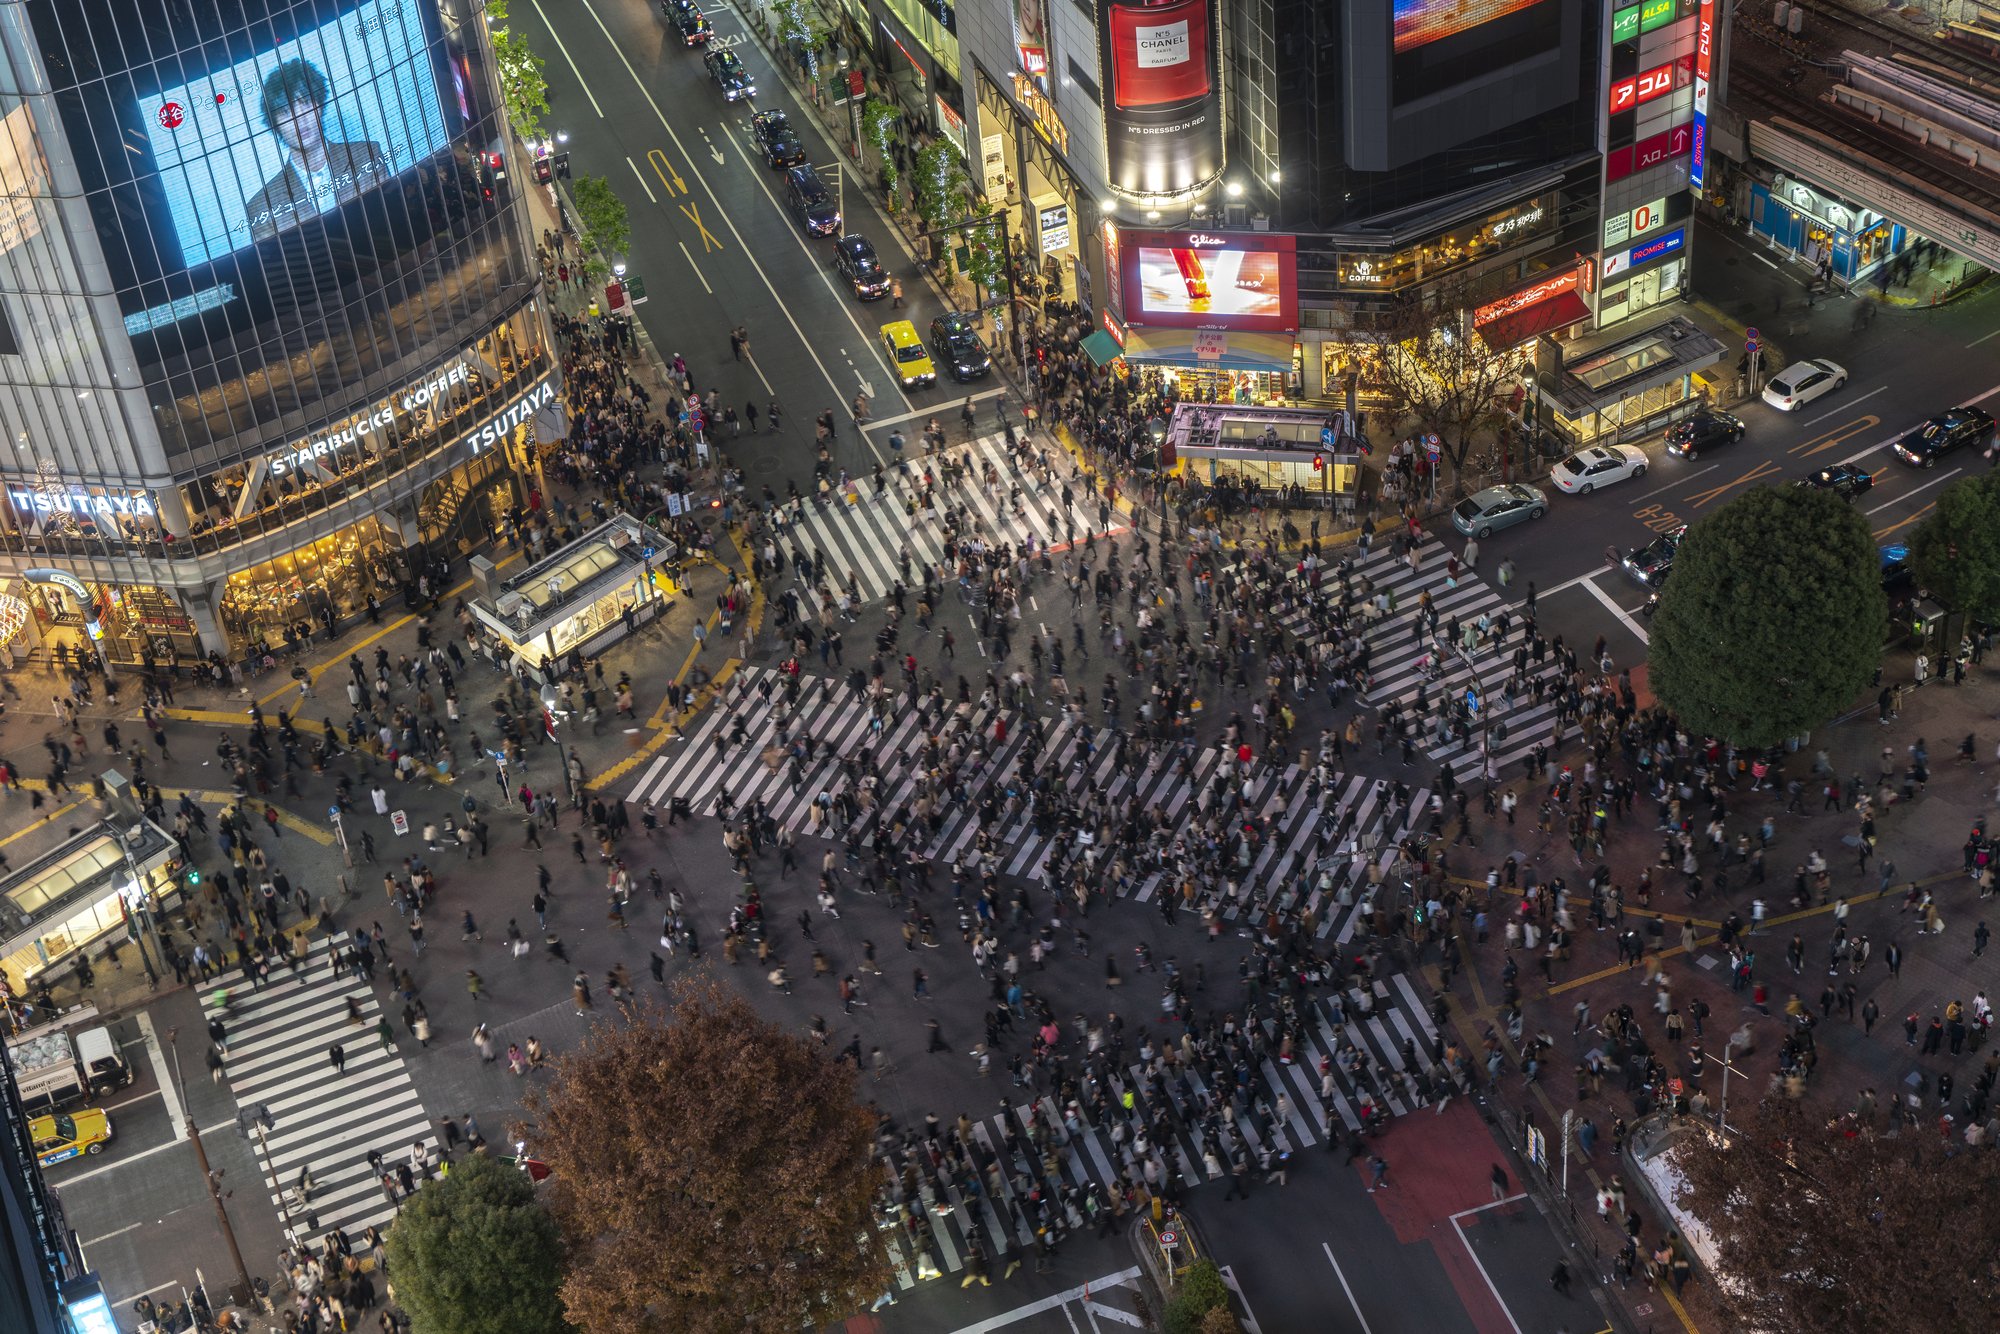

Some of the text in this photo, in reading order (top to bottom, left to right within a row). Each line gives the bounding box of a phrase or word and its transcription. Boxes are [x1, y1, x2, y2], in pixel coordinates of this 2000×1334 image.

[1614, 2, 1670, 31] レイク ALSA
[1141, 36, 1186, 48] CHANEL
[1700, 21, 1711, 56] アコム
[1617, 72, 1670, 105] アコム
[158, 105, 186, 126] 渋谷
[1143, 125, 1180, 135] DRESSED
[1182, 122, 1190, 130] IN
[1191, 115, 1205, 126] RED
[1641, 149, 1660, 166] 入口
[1694, 124, 1704, 167] PROMISE
[1635, 206, 1659, 231] 0円
[1189, 234, 1226, 248] Glico
[1633, 242, 1665, 260] PROMISE
[272, 363, 468, 474] STARBUCKS COFFEE
[467, 381, 554, 454] TSUTAYA
[12, 491, 154, 516] TSUTAYA
[1633, 504, 1682, 532] 8-20
